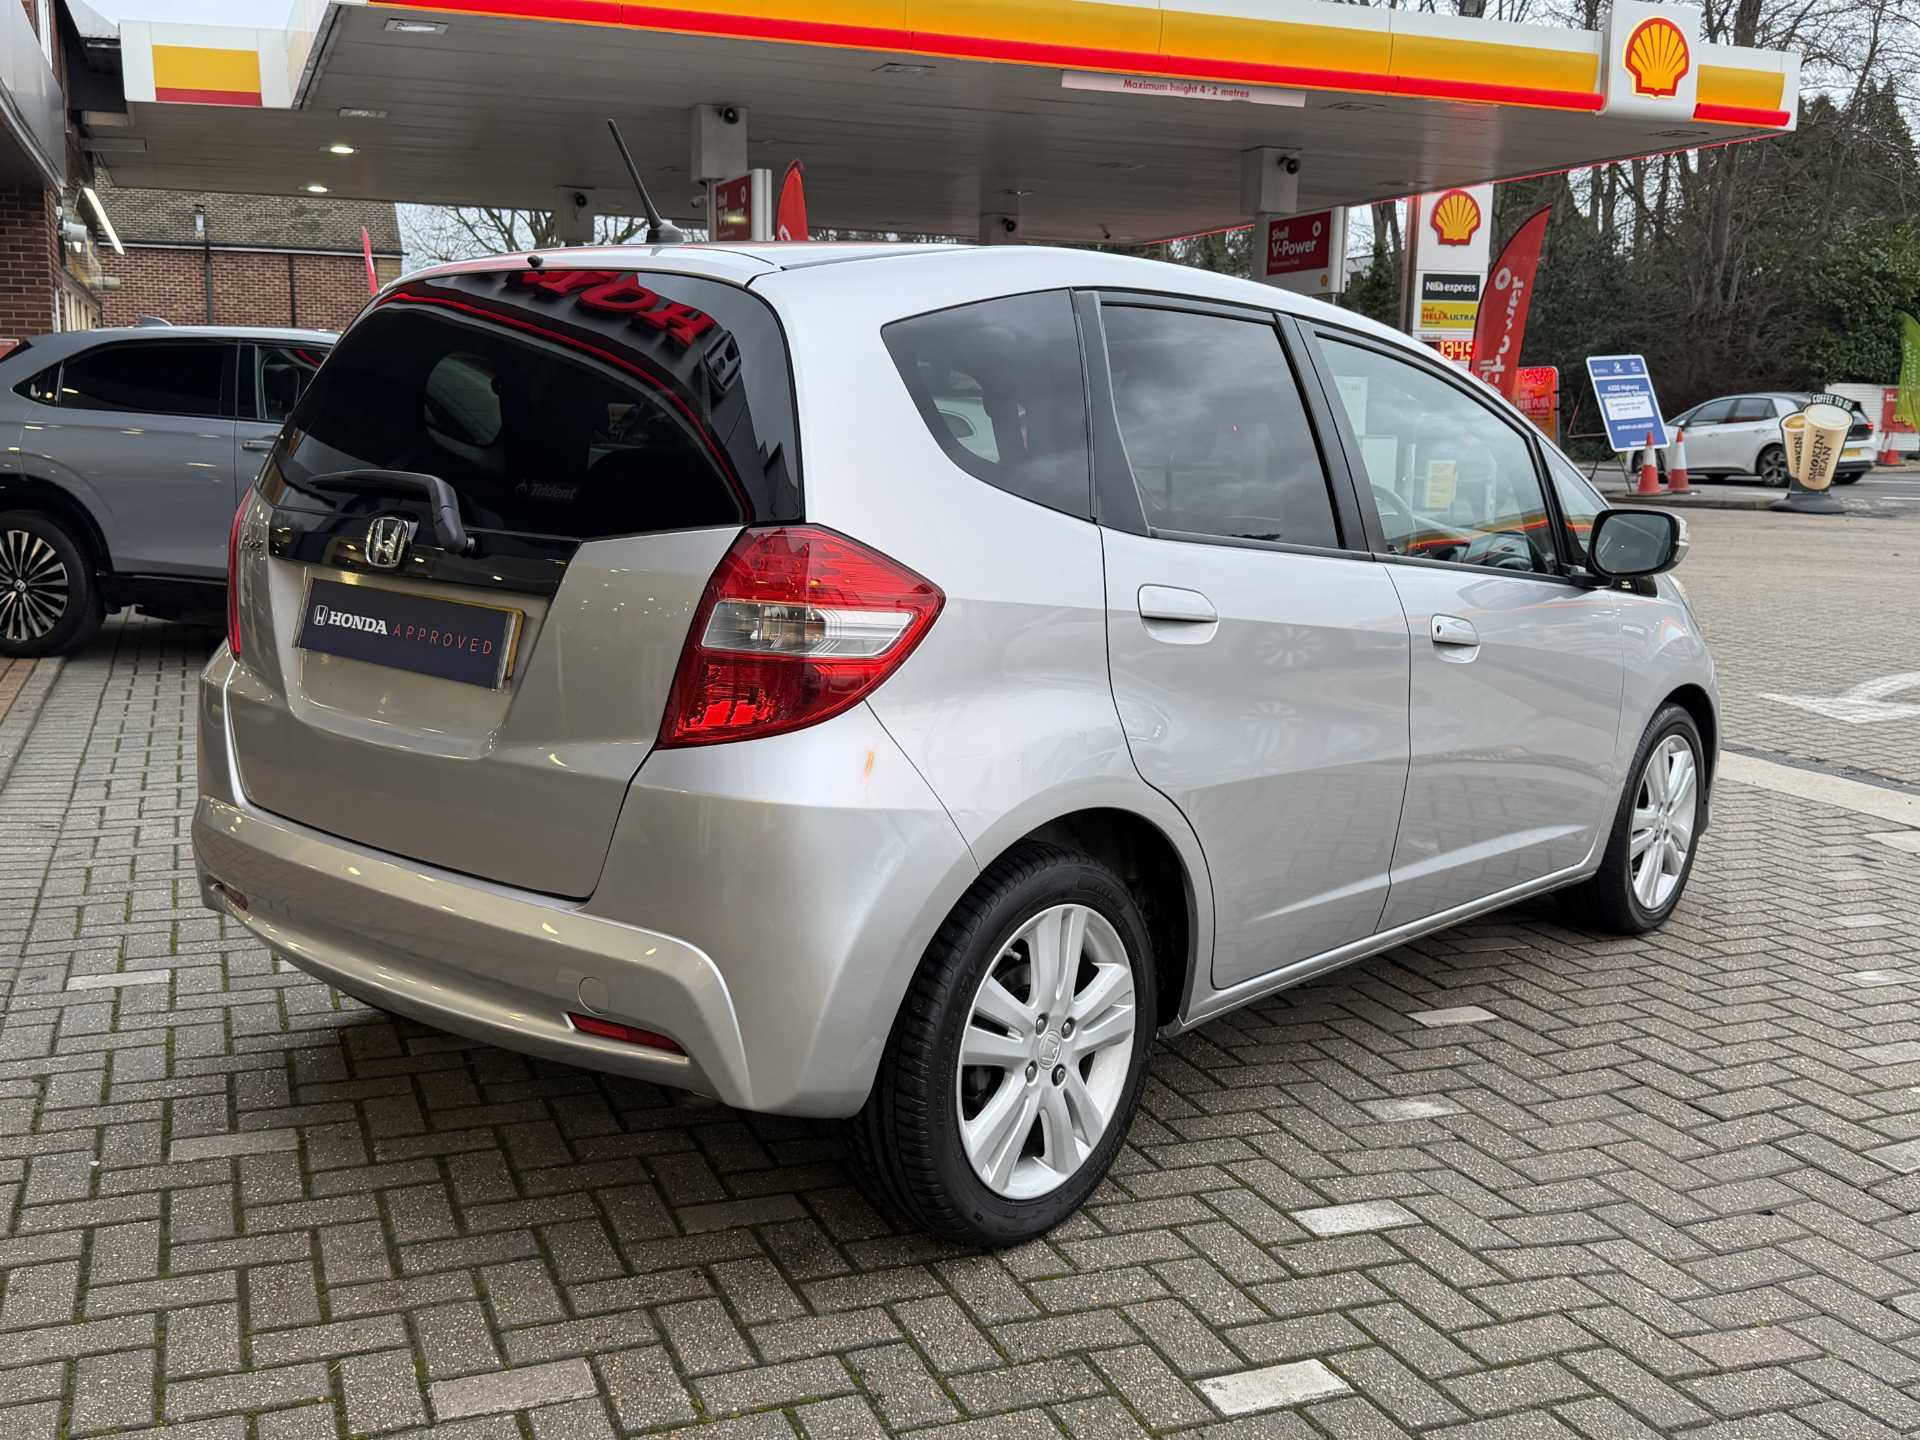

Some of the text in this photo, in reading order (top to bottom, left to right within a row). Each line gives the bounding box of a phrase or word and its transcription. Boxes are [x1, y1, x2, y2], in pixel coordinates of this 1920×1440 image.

[1123, 79, 1167, 91] Maximum
[1170, 82, 1197, 96] height
[1221, 88, 1249, 98] metres
[1272, 225, 1289, 241] Shell
[1272, 239, 1317, 257] V-Power
[1444, 283, 1477, 294] express
[1450, 313, 1475, 321] ULTRA
[1812, 393, 1834, 404] COFFEE
[529, 482, 578, 500] Trident
[328, 611, 493, 655] HONDA APPROVED
